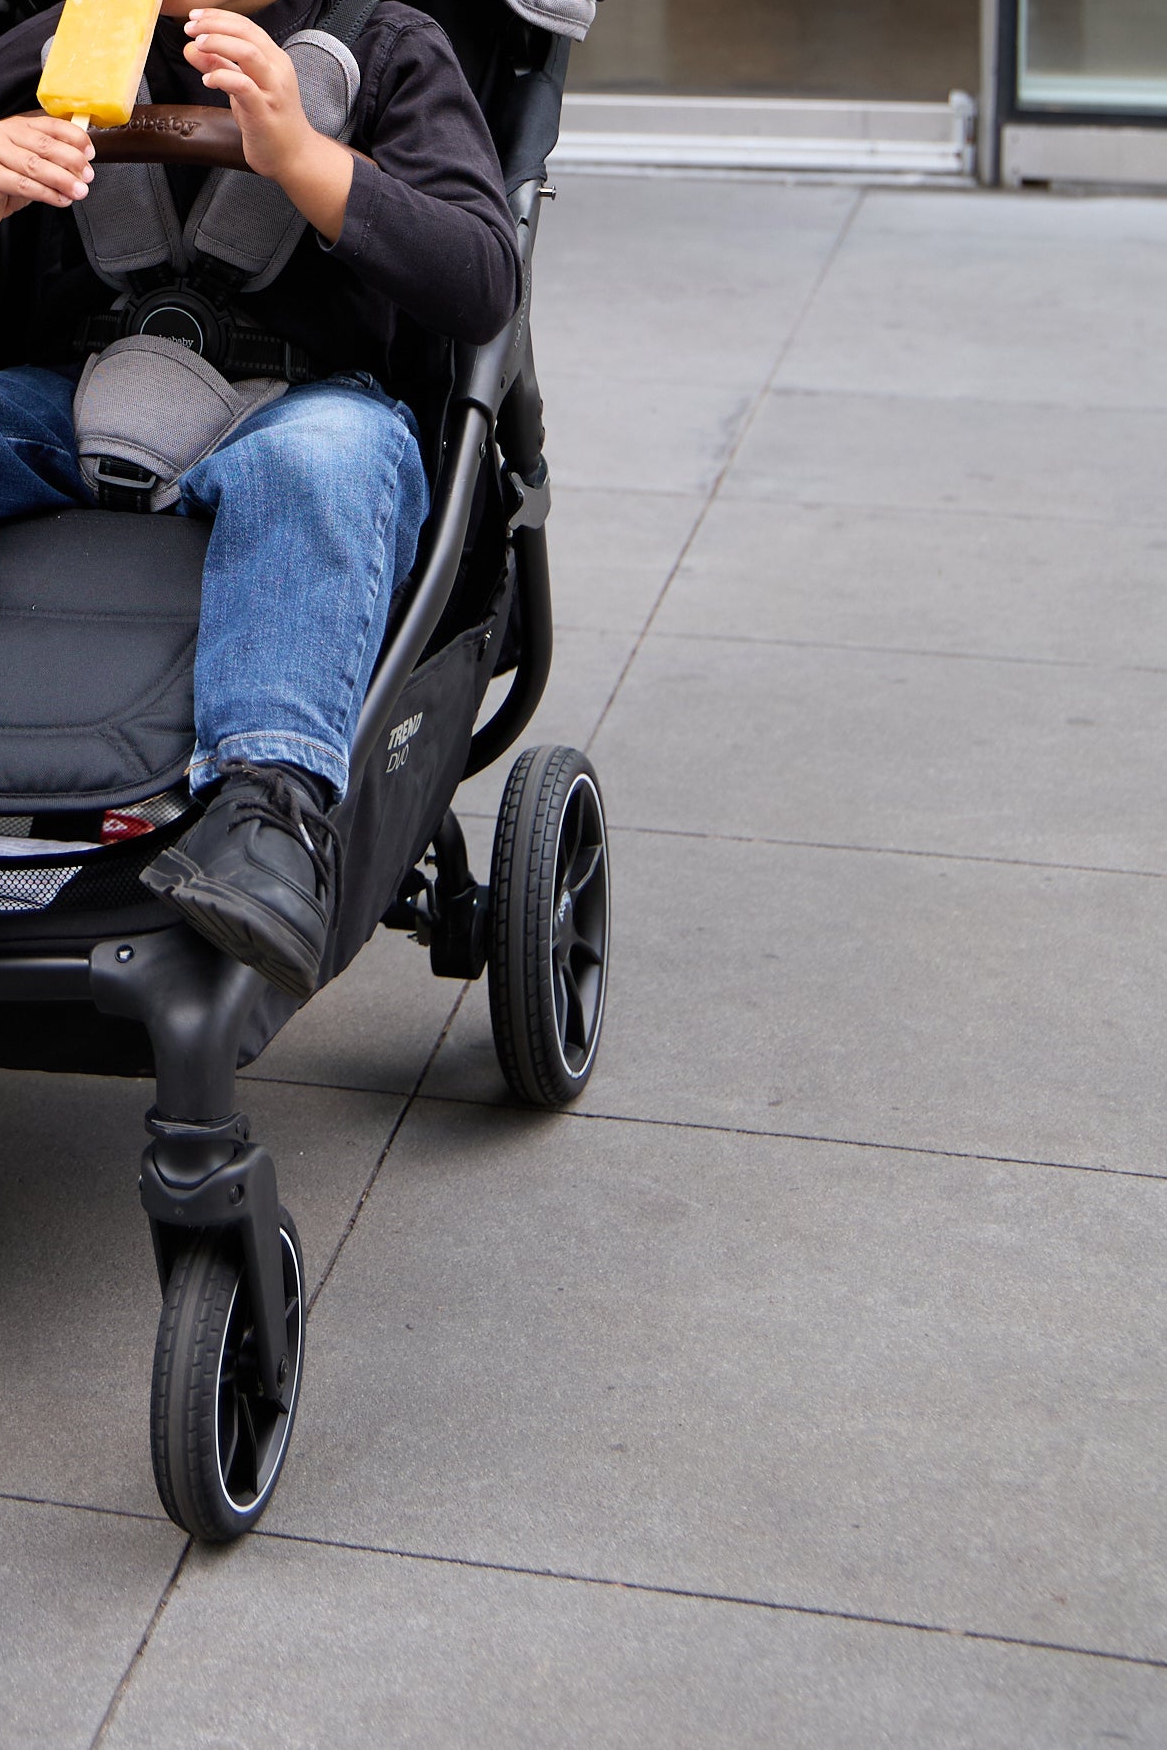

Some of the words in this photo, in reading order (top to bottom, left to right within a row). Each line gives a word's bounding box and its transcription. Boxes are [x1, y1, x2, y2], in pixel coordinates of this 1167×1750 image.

[118, 114, 201, 140] obaby
[387, 711, 424, 750] TREND
[385, 743, 410, 774] DUO
